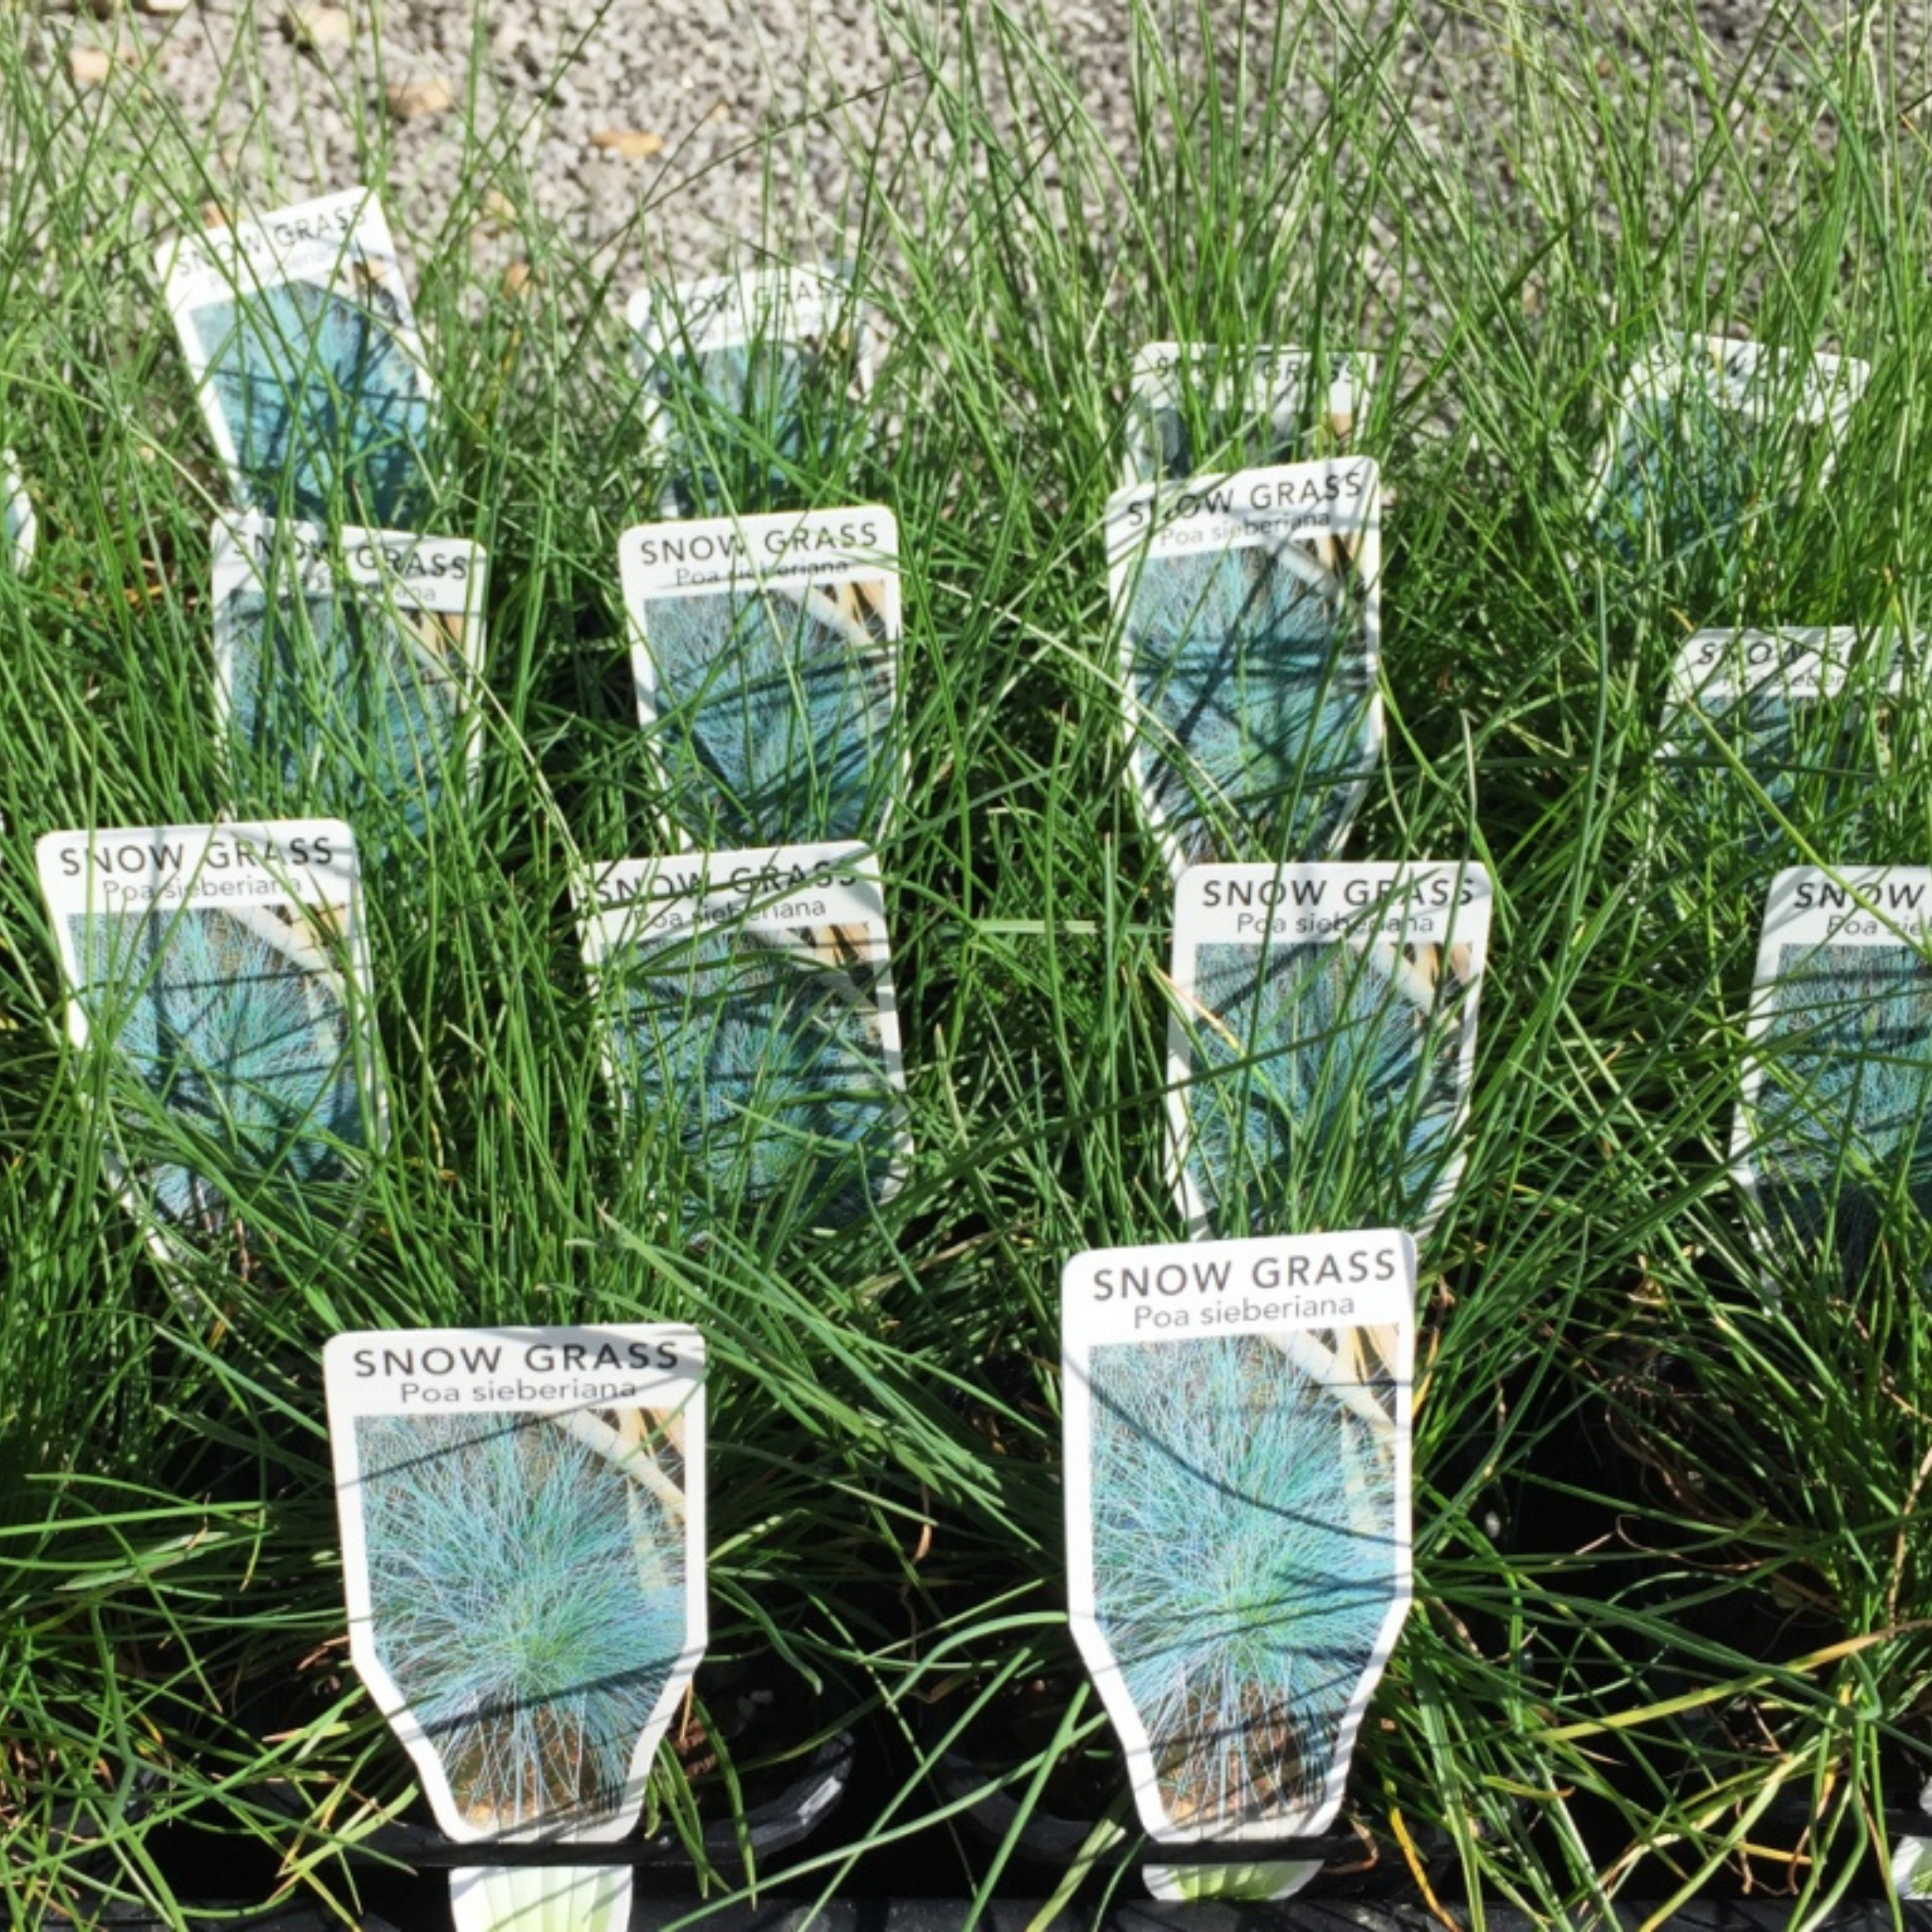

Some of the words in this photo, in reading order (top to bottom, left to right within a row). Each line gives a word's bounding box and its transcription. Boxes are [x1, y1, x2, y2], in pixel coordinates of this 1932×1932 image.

[1249, 472, 1363, 511] GRASS
[641, 534, 747, 566] SNOW
[763, 522, 878, 555] GRASS
[1159, 528, 1205, 547] Poa
[1210, 512, 1331, 541] sieberiana
[356, 544, 468, 580] GRASS
[675, 568, 720, 587] Poa
[727, 557, 848, 581] ieberiana
[59, 841, 184, 877] SNOW
[206, 836, 334, 870] GRASS
[103, 880, 148, 902] Poa
[730, 859, 858, 894] GRASS
[1202, 879, 1327, 908] SNOW
[1343, 878, 1474, 908] GRASS
[691, 899, 827, 925] iebriana
[1793, 882, 1925, 909] SNOW
[1826, 914, 1877, 936] Poa
[1092, 1260, 1233, 1302] SNOW
[1252, 1248, 1397, 1290] GRASS
[1134, 1306, 1190, 1330] Poa
[1200, 1295, 1356, 1325] sieberiana
[353, 1345, 503, 1378] SNOW
[524, 1341, 680, 1374] GRASS
[400, 1382, 460, 1405] Poa
[473, 1377, 638, 1403] sieberiana
